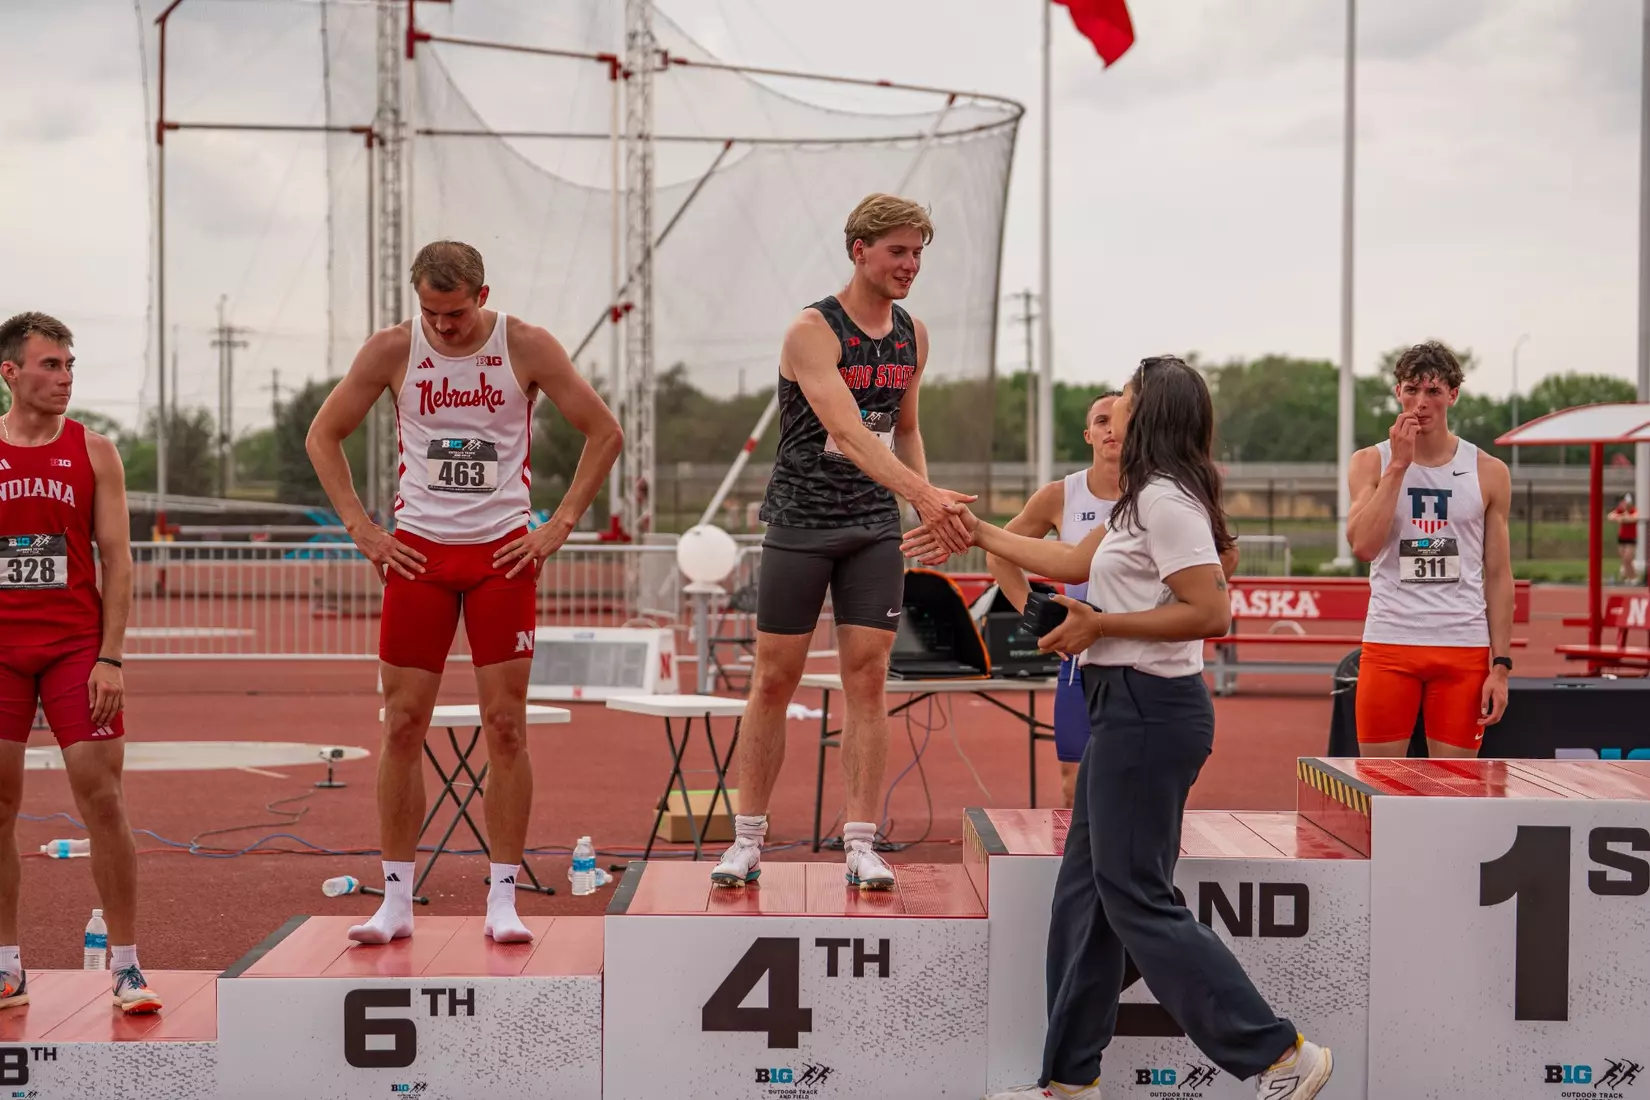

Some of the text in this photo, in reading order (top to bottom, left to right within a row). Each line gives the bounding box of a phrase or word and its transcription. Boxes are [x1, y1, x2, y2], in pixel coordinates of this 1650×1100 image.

[415, 372, 505, 416] Nebraska
[439, 461, 485, 486] 463
[7, 558, 55, 583] 328
[1414, 557, 1446, 578] 311
[514, 631, 534, 652] N
